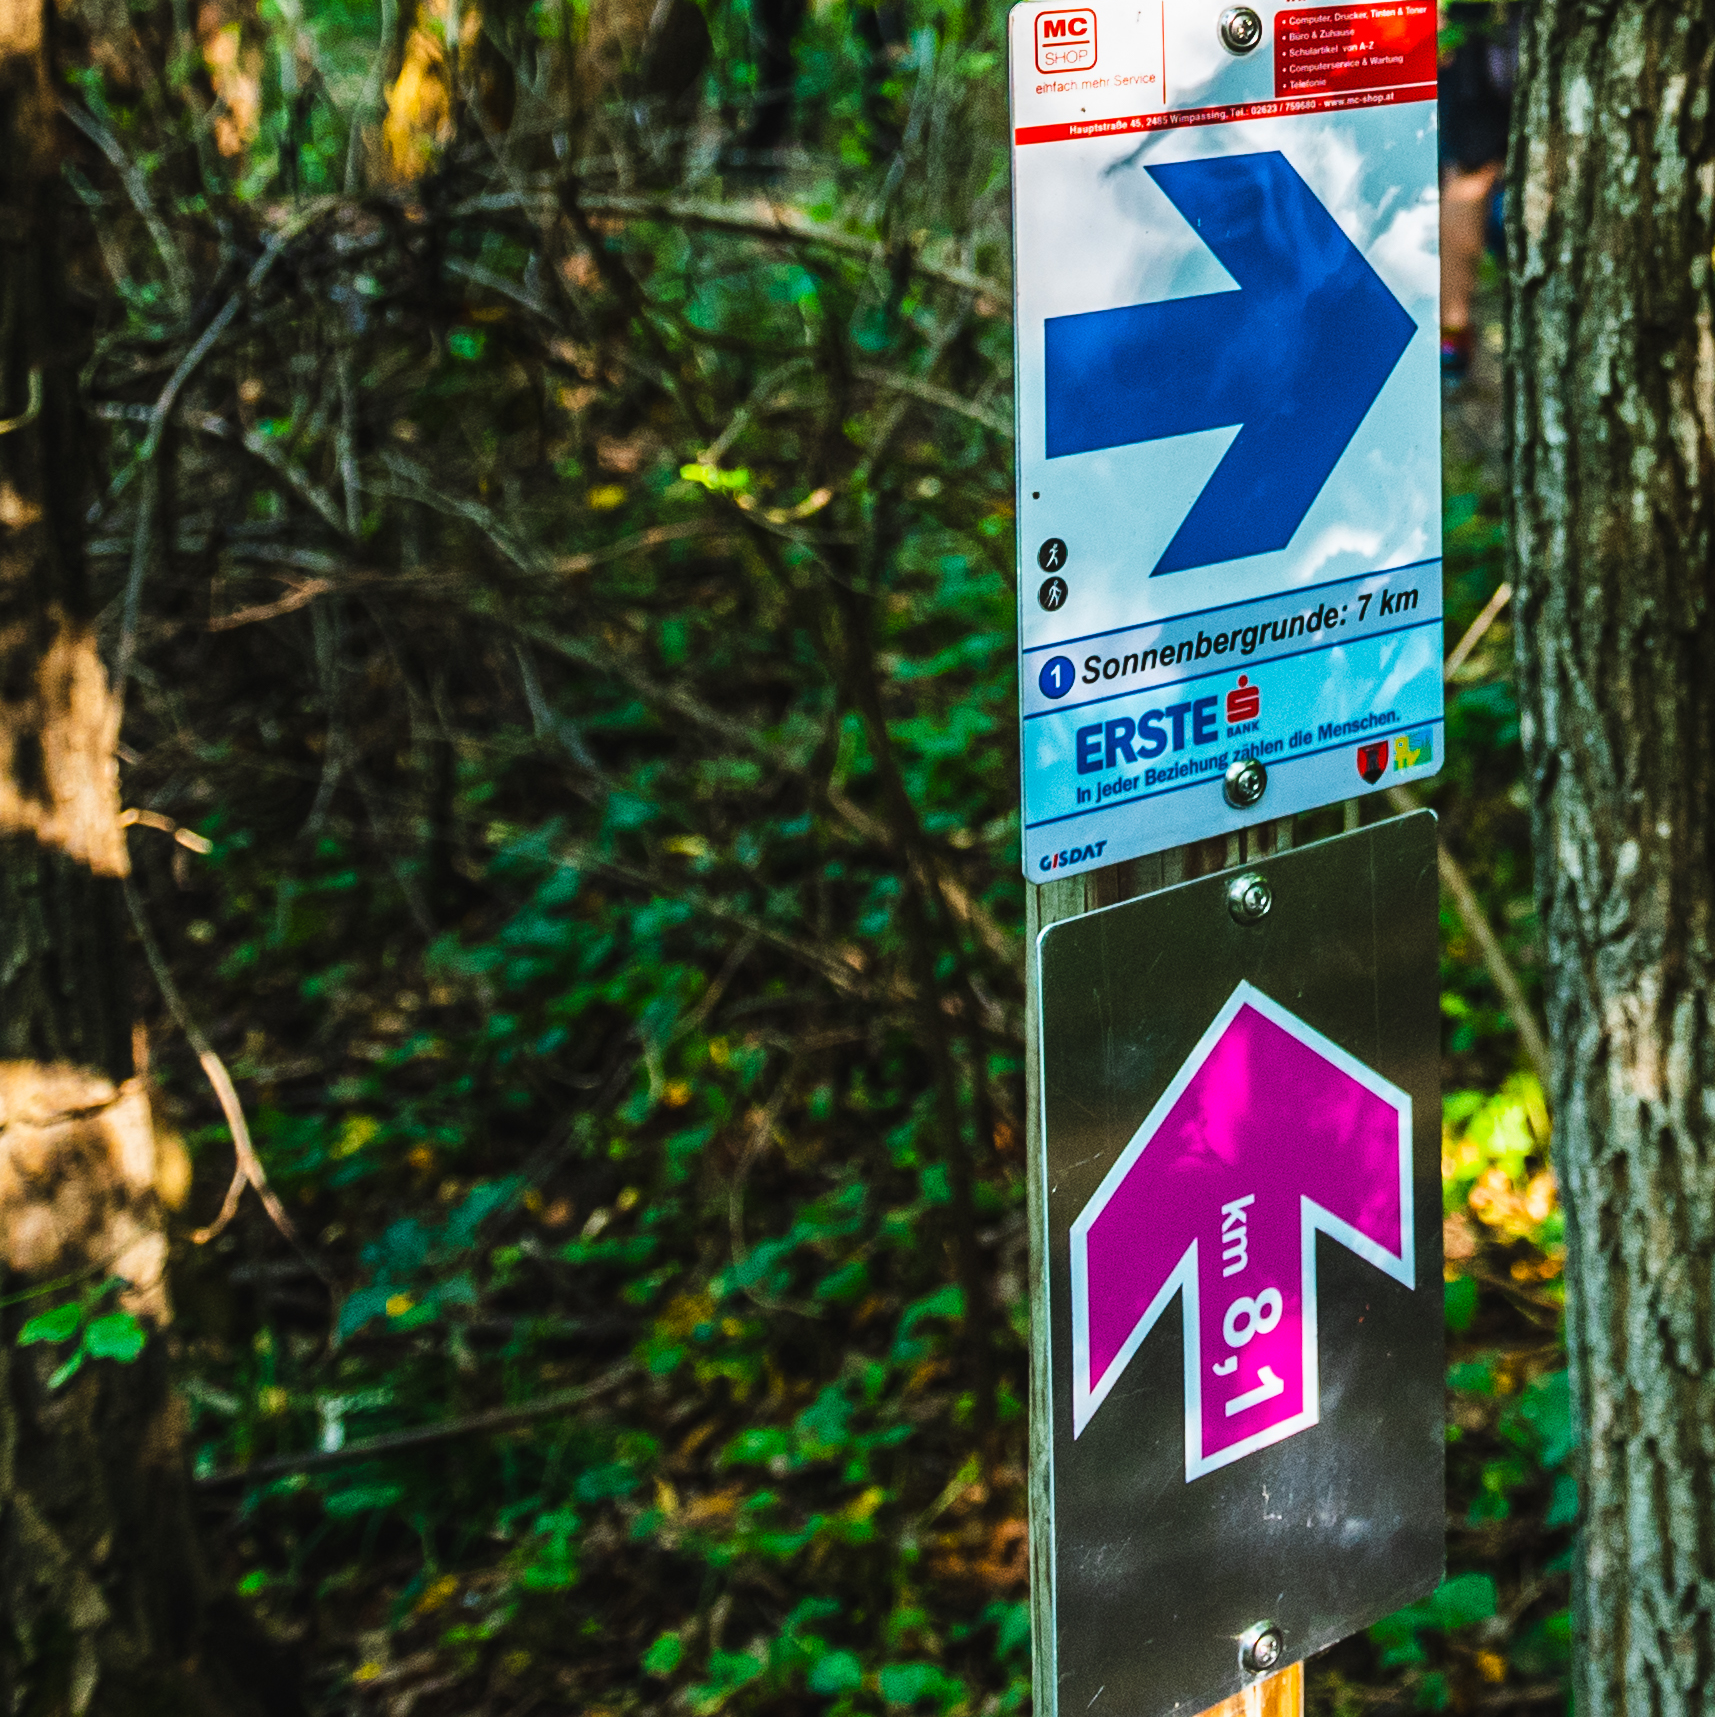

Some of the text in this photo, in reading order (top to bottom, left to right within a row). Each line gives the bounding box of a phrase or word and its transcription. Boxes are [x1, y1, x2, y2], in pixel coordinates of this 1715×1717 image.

[1371, 8, 1396, 18] Tinten
[1397, 7, 1403, 16] &
[1406, 6, 1427, 15] Toner
[1043, 17, 1088, 38] MC
[1289, 28, 1355, 42] Büro & Zuhause
[1045, 49, 1088, 65] SHOP
[1289, 41, 1375, 57] Schulartikel von A-Z
[1289, 55, 1404, 73] Computerservice & Wartung
[1035, 74, 1156, 95] einfach mehr Service
[1290, 79, 1327, 89] Telefonie
[1069, 121, 1128, 136] Hauptstraße
[1130, 119, 1145, 129] 45,
[1081, 588, 1419, 685] Sonnenbergrunde: 7 km
[1050, 664, 1061, 688] 1
[1075, 694, 1219, 776] ERSTE
[1226, 721, 1260, 739] BANK
[1076, 709, 1400, 804] In jeder Beziehung zählen die Menschen.
[1039, 839, 1108, 872] GISDAT
[1211, 1193, 1285, 1418] km 8,1
